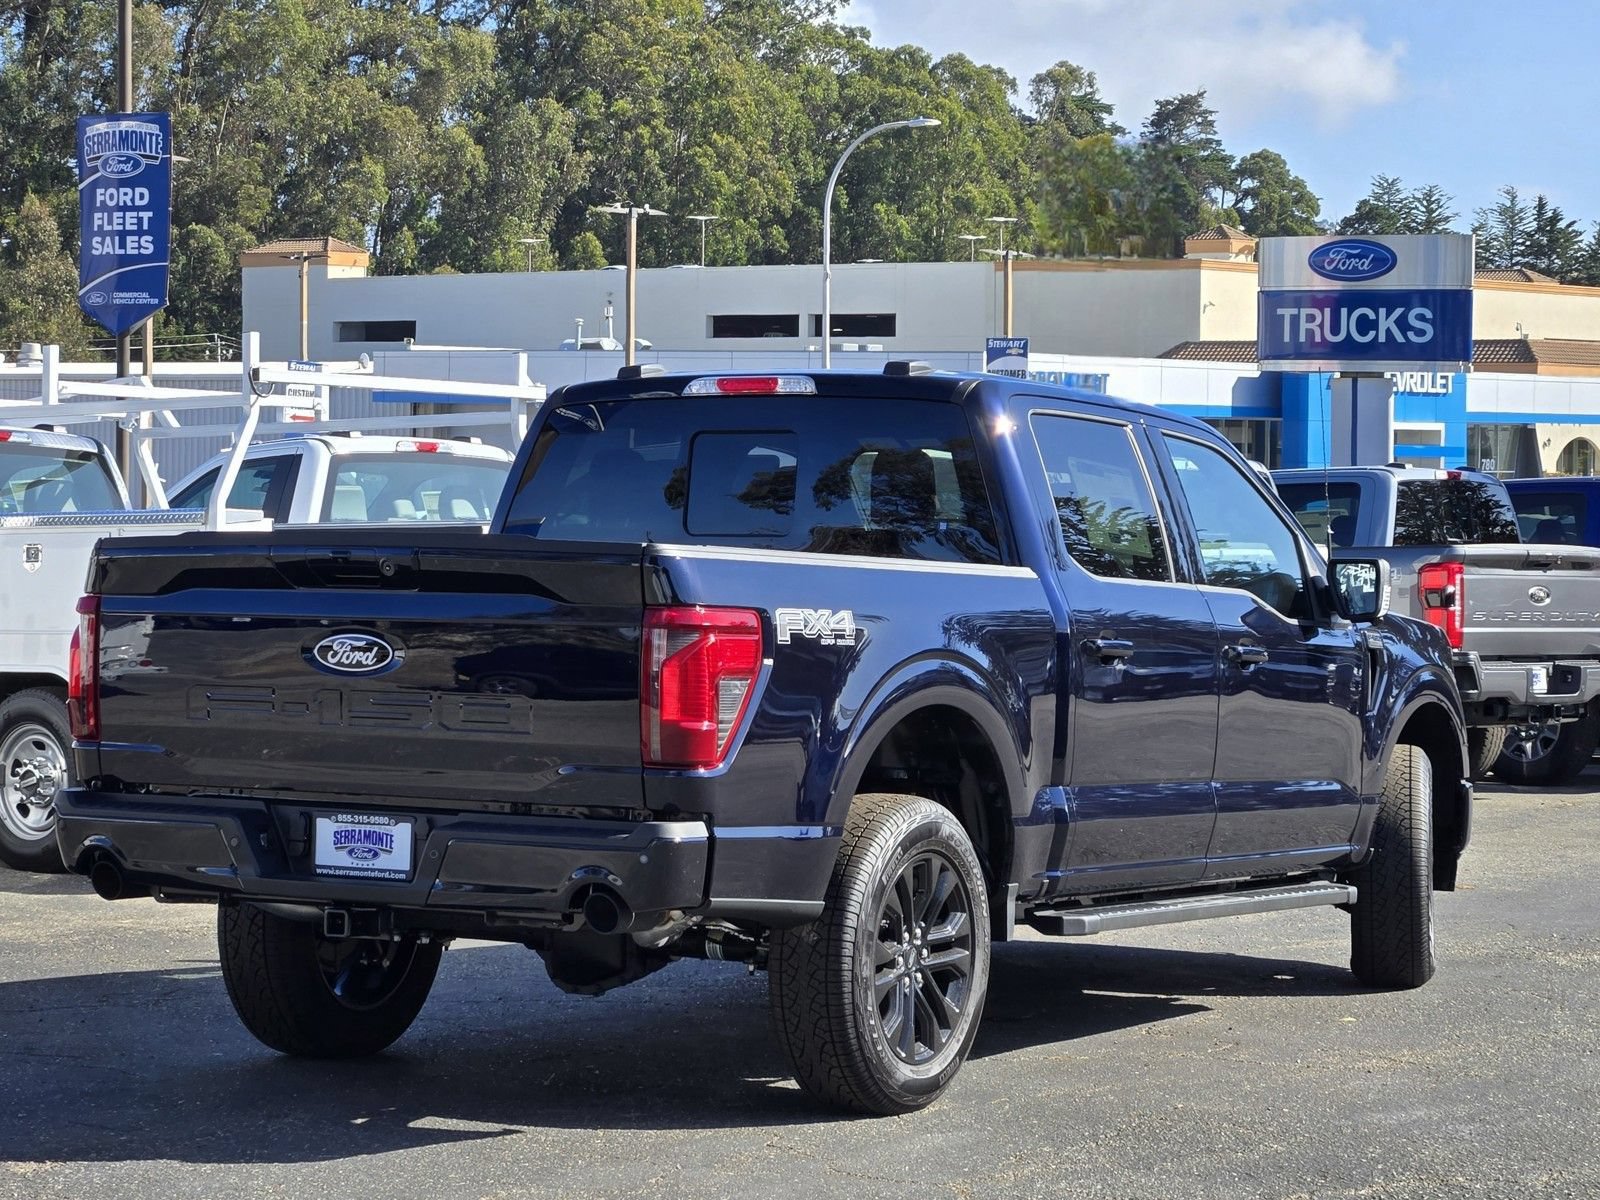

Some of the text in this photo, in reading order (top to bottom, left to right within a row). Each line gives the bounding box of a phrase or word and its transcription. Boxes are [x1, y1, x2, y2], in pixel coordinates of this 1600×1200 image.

[85, 130, 161, 157] SERRAMONTE
[106, 156, 134, 172] Ford
[96, 187, 149, 207] FORD
[93, 211, 153, 231] FLEET
[91, 235, 154, 255] SALES
[1324, 247, 1374, 271] Ford
[1276, 307, 1434, 343] TRUCKS
[988, 339, 1026, 348] STEWART
[1481, 458, 1495, 470] 780
[775, 607, 856, 644] FX4
[1472, 611, 1600, 621] SUPER DUTY
[327, 638, 379, 665] Ford
[186, 684, 534, 734] F-150
[337, 814, 389, 825] 855-315-9580
[333, 829, 394, 849] SERRAMONTE
[352, 847, 374, 859] Ford
[316, 867, 407, 880] www.serramonteford.com
